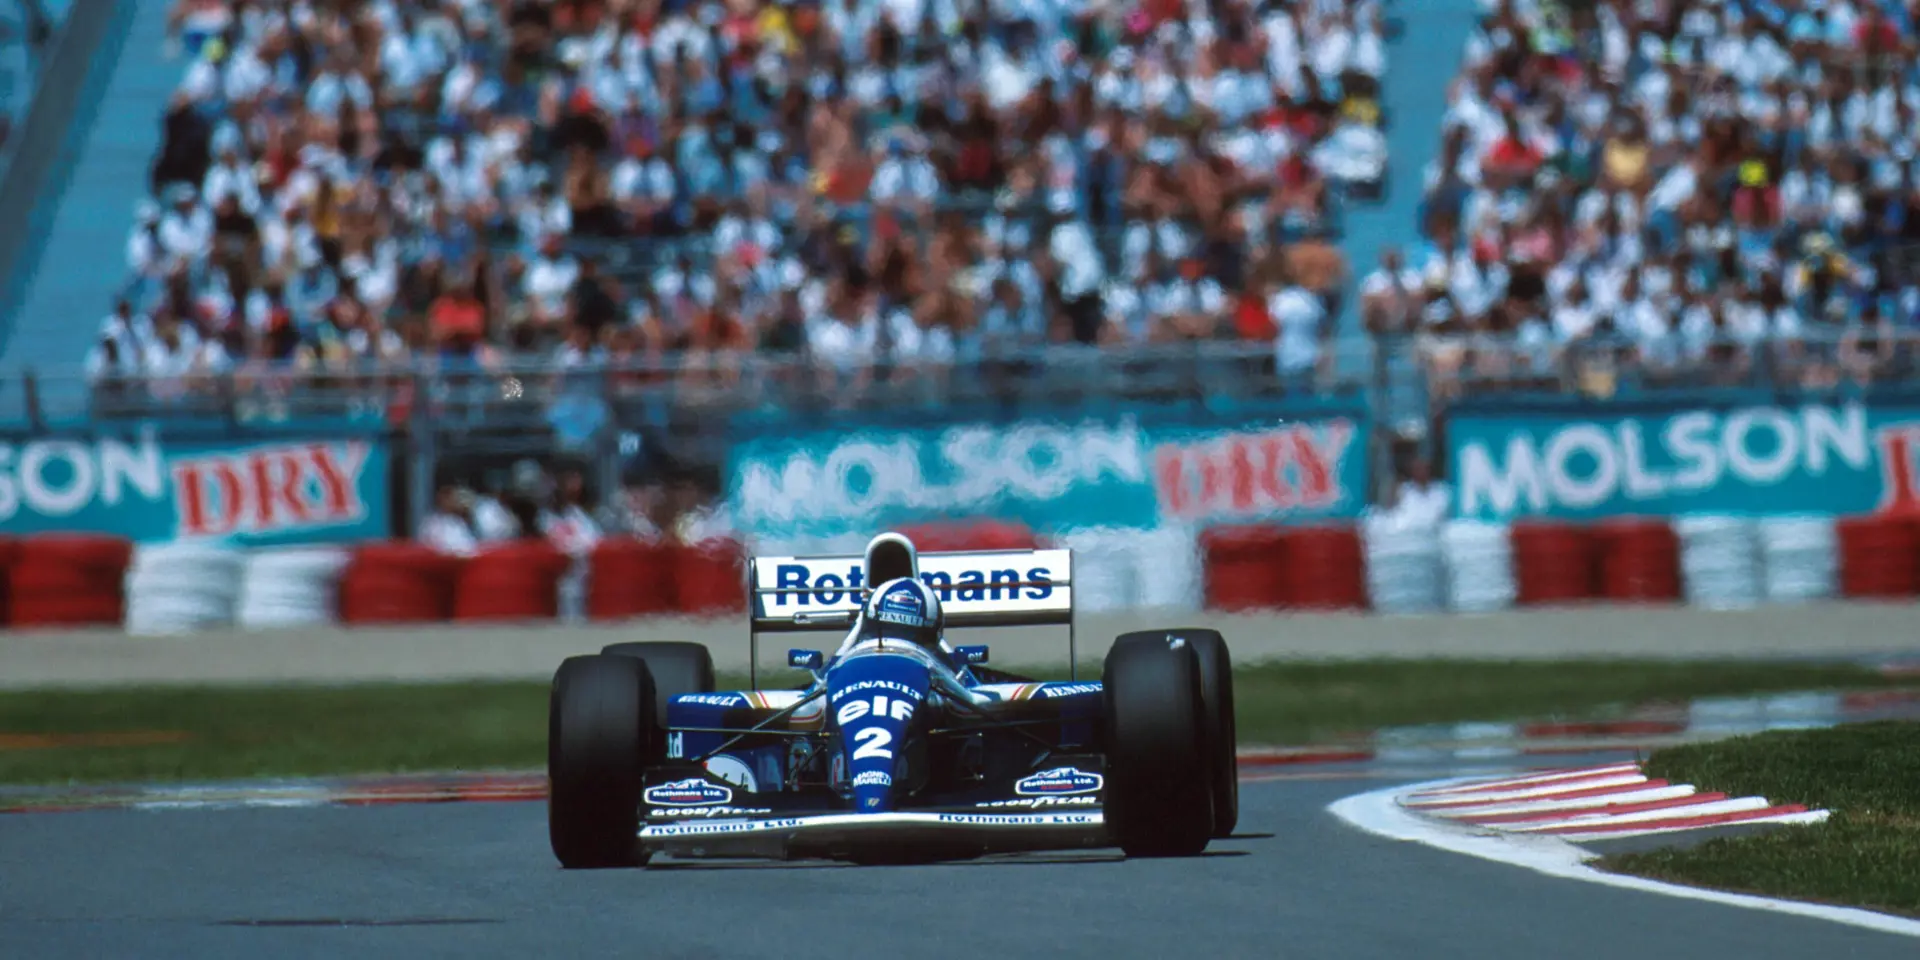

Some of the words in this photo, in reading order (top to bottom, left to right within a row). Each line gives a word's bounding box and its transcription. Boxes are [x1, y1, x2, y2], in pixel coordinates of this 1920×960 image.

[738, 414, 1144, 518] MOLSON
[1458, 403, 1867, 513] MOLSON
[174, 439, 369, 534] DRY
[776, 565, 1052, 606] Rotmans
[832, 680, 924, 703] RENAULT
[1041, 683, 1103, 698] RENAUL
[837, 695, 914, 726] elf
[853, 726, 892, 760] 2
